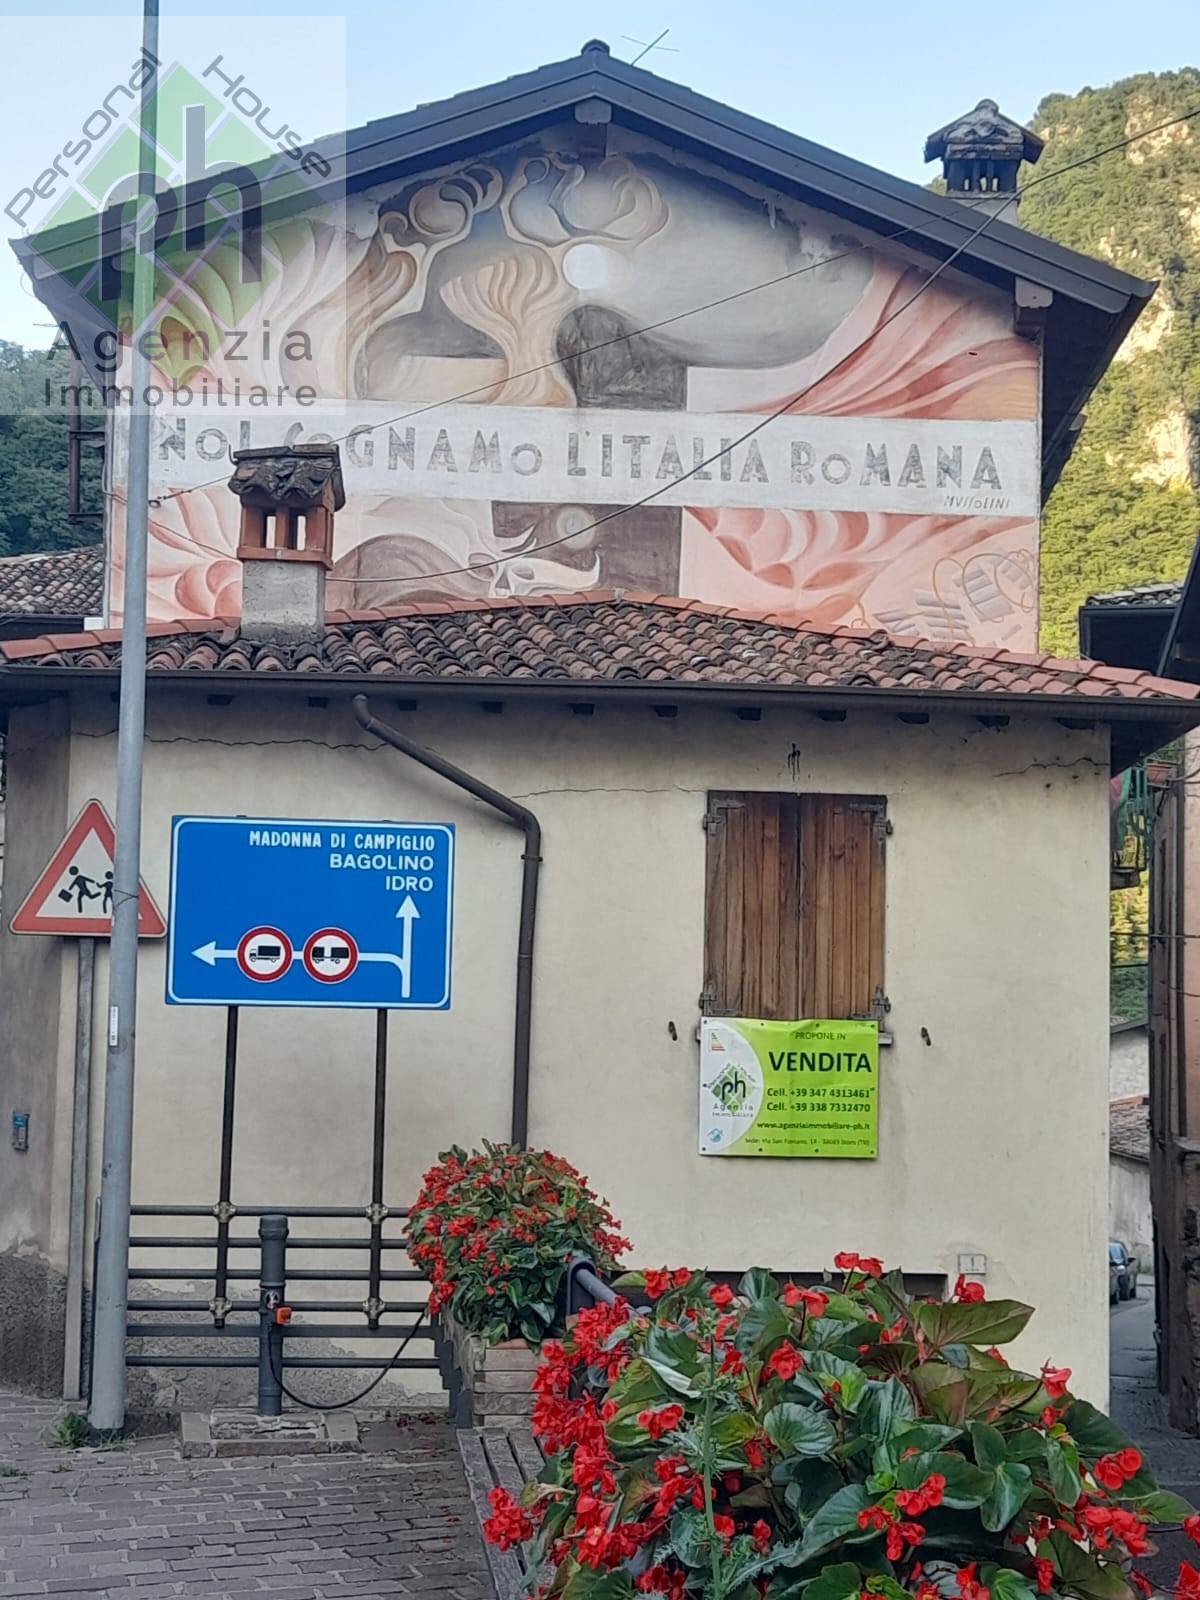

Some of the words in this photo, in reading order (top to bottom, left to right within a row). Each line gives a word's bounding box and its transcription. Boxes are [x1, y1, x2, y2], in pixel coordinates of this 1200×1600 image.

[790, 440, 1003, 490] ROMANA
[250, 830, 322, 848] MADONNA
[330, 833, 346, 848] DI
[354, 834, 435, 851] CAMPIGLIO
[330, 853, 434, 871] BAGOLINO
[385, 875, 434, 892] IDRO
[795, 1031, 835, 1040] PROPONE
[837, 1032, 847, 1040] IN
[768, 1051, 872, 1073] VENDITA
[722, 1071, 746, 1101] ph
[767, 1087, 788, 1097] Cell.
[790, 1088, 807, 1097] +39
[809, 1088, 827, 1097] 347
[767, 1102, 788, 1111] Cell.
[790, 1103, 807, 1111] +39
[809, 1103, 827, 1111] 338
[830, 1103, 871, 1112] 7332470
